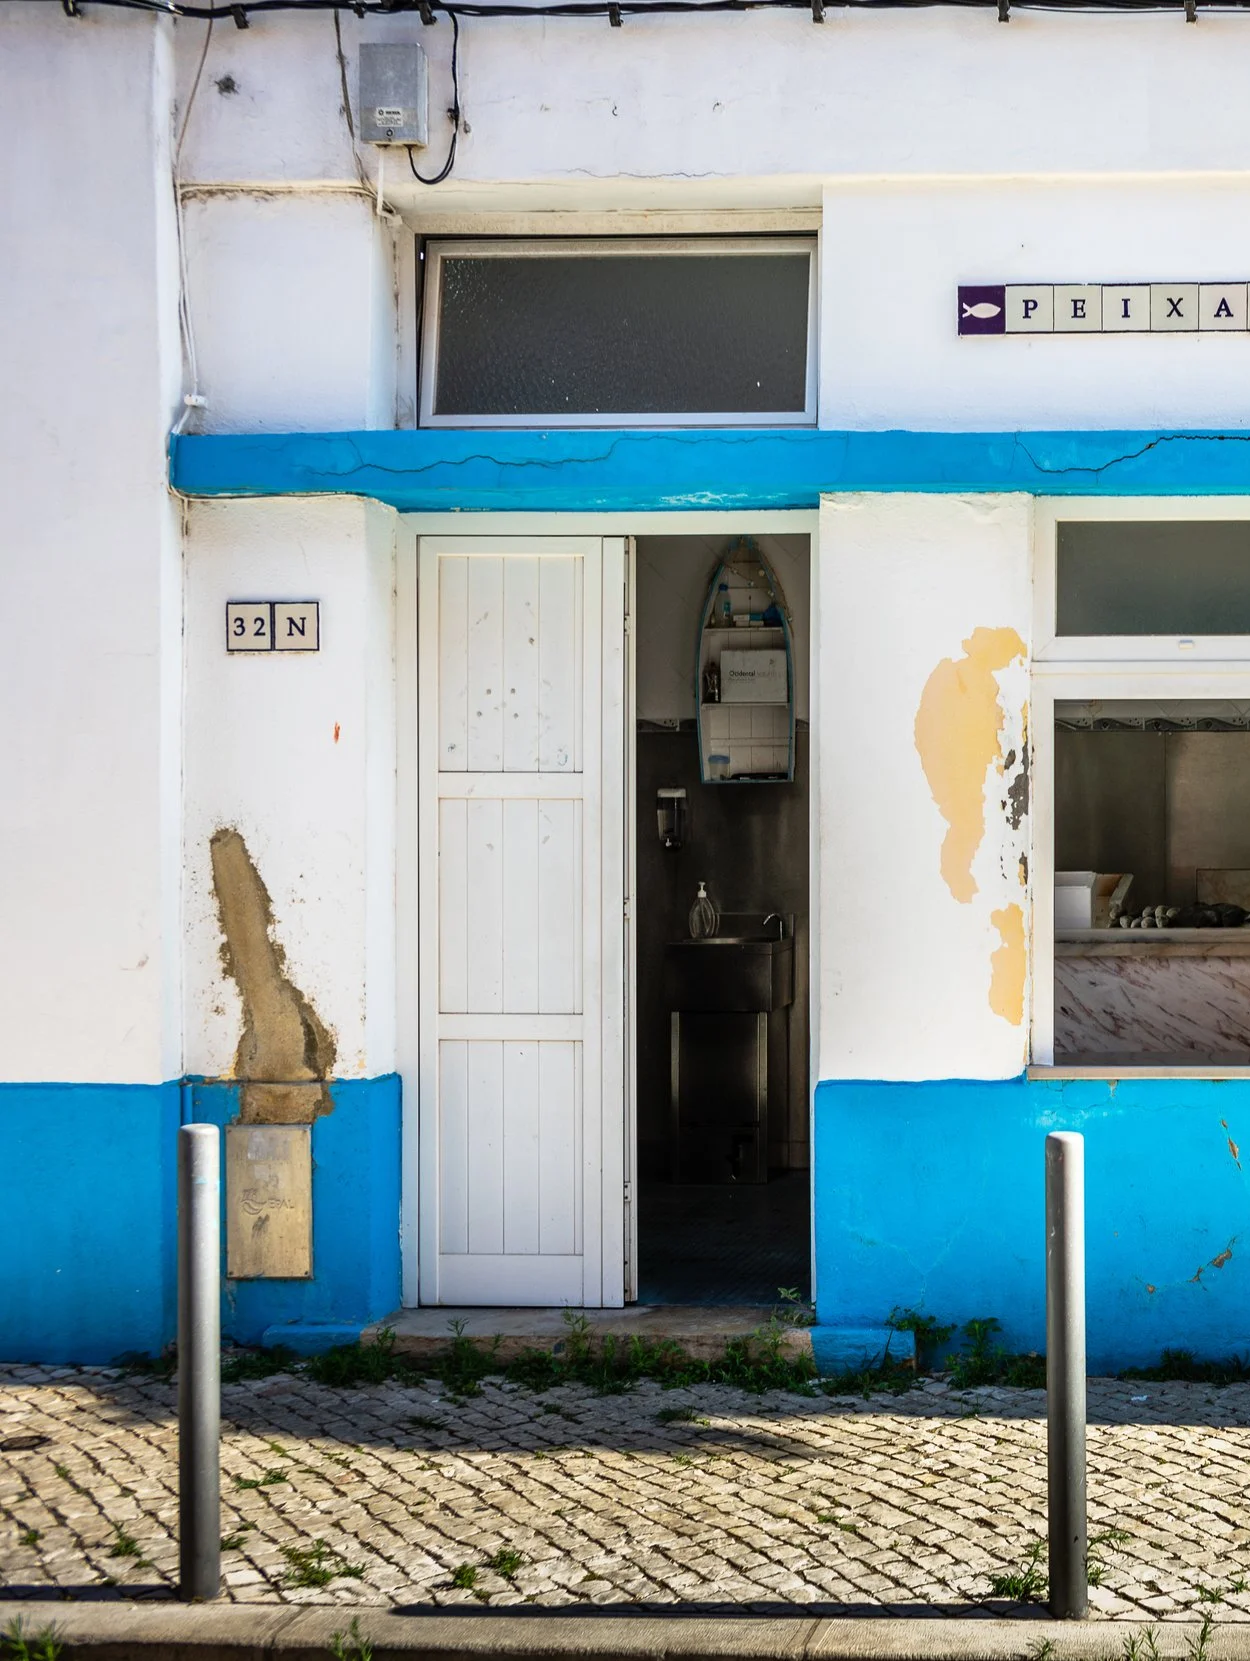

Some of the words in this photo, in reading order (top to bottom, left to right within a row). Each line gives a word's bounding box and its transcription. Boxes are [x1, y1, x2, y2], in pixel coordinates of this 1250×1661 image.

[233, 617, 266, 637] 32
[286, 617, 307, 637] N
[729, 669, 756, 678] Ocidental
[268, 1198, 295, 1209] EPAL
